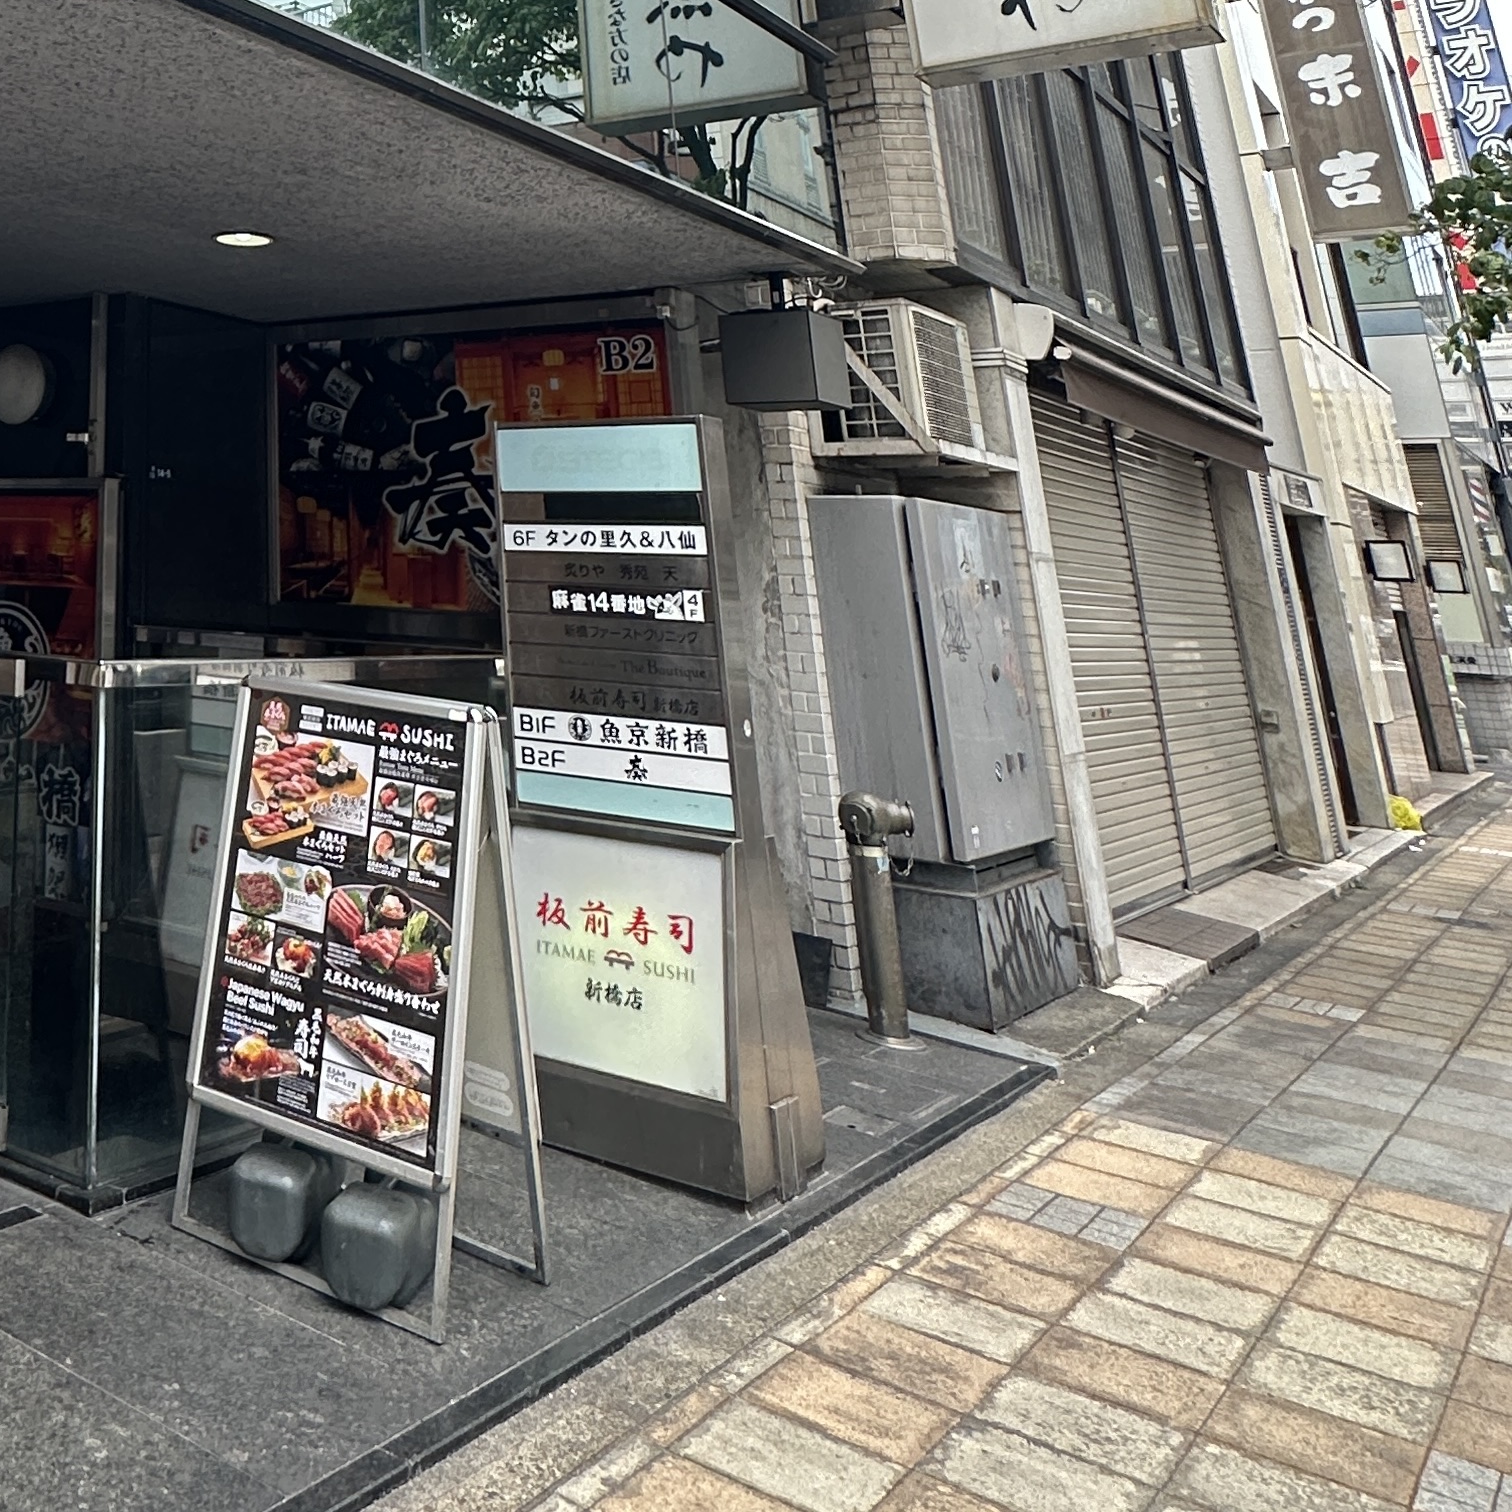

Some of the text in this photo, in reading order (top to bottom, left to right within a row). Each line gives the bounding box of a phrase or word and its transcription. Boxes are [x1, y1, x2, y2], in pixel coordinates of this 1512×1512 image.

[1298, 52, 1382, 209] 末吉
[597, 336, 656, 375] B2
[513, 529, 696, 550] 6F タンの里久&八仙
[551, 590, 646, 615] 麻雀14番地
[326, 713, 376, 737] ITAMAE
[400, 724, 455, 751] SUSHI
[519, 714, 708, 755] B1F 魚京新橋
[522, 747, 566, 767] B2F
[537, 893, 694, 955] 板前寿司
[537, 940, 695, 985] ITAMAE SUSHI
[585, 977, 643, 1010] 新橋店
